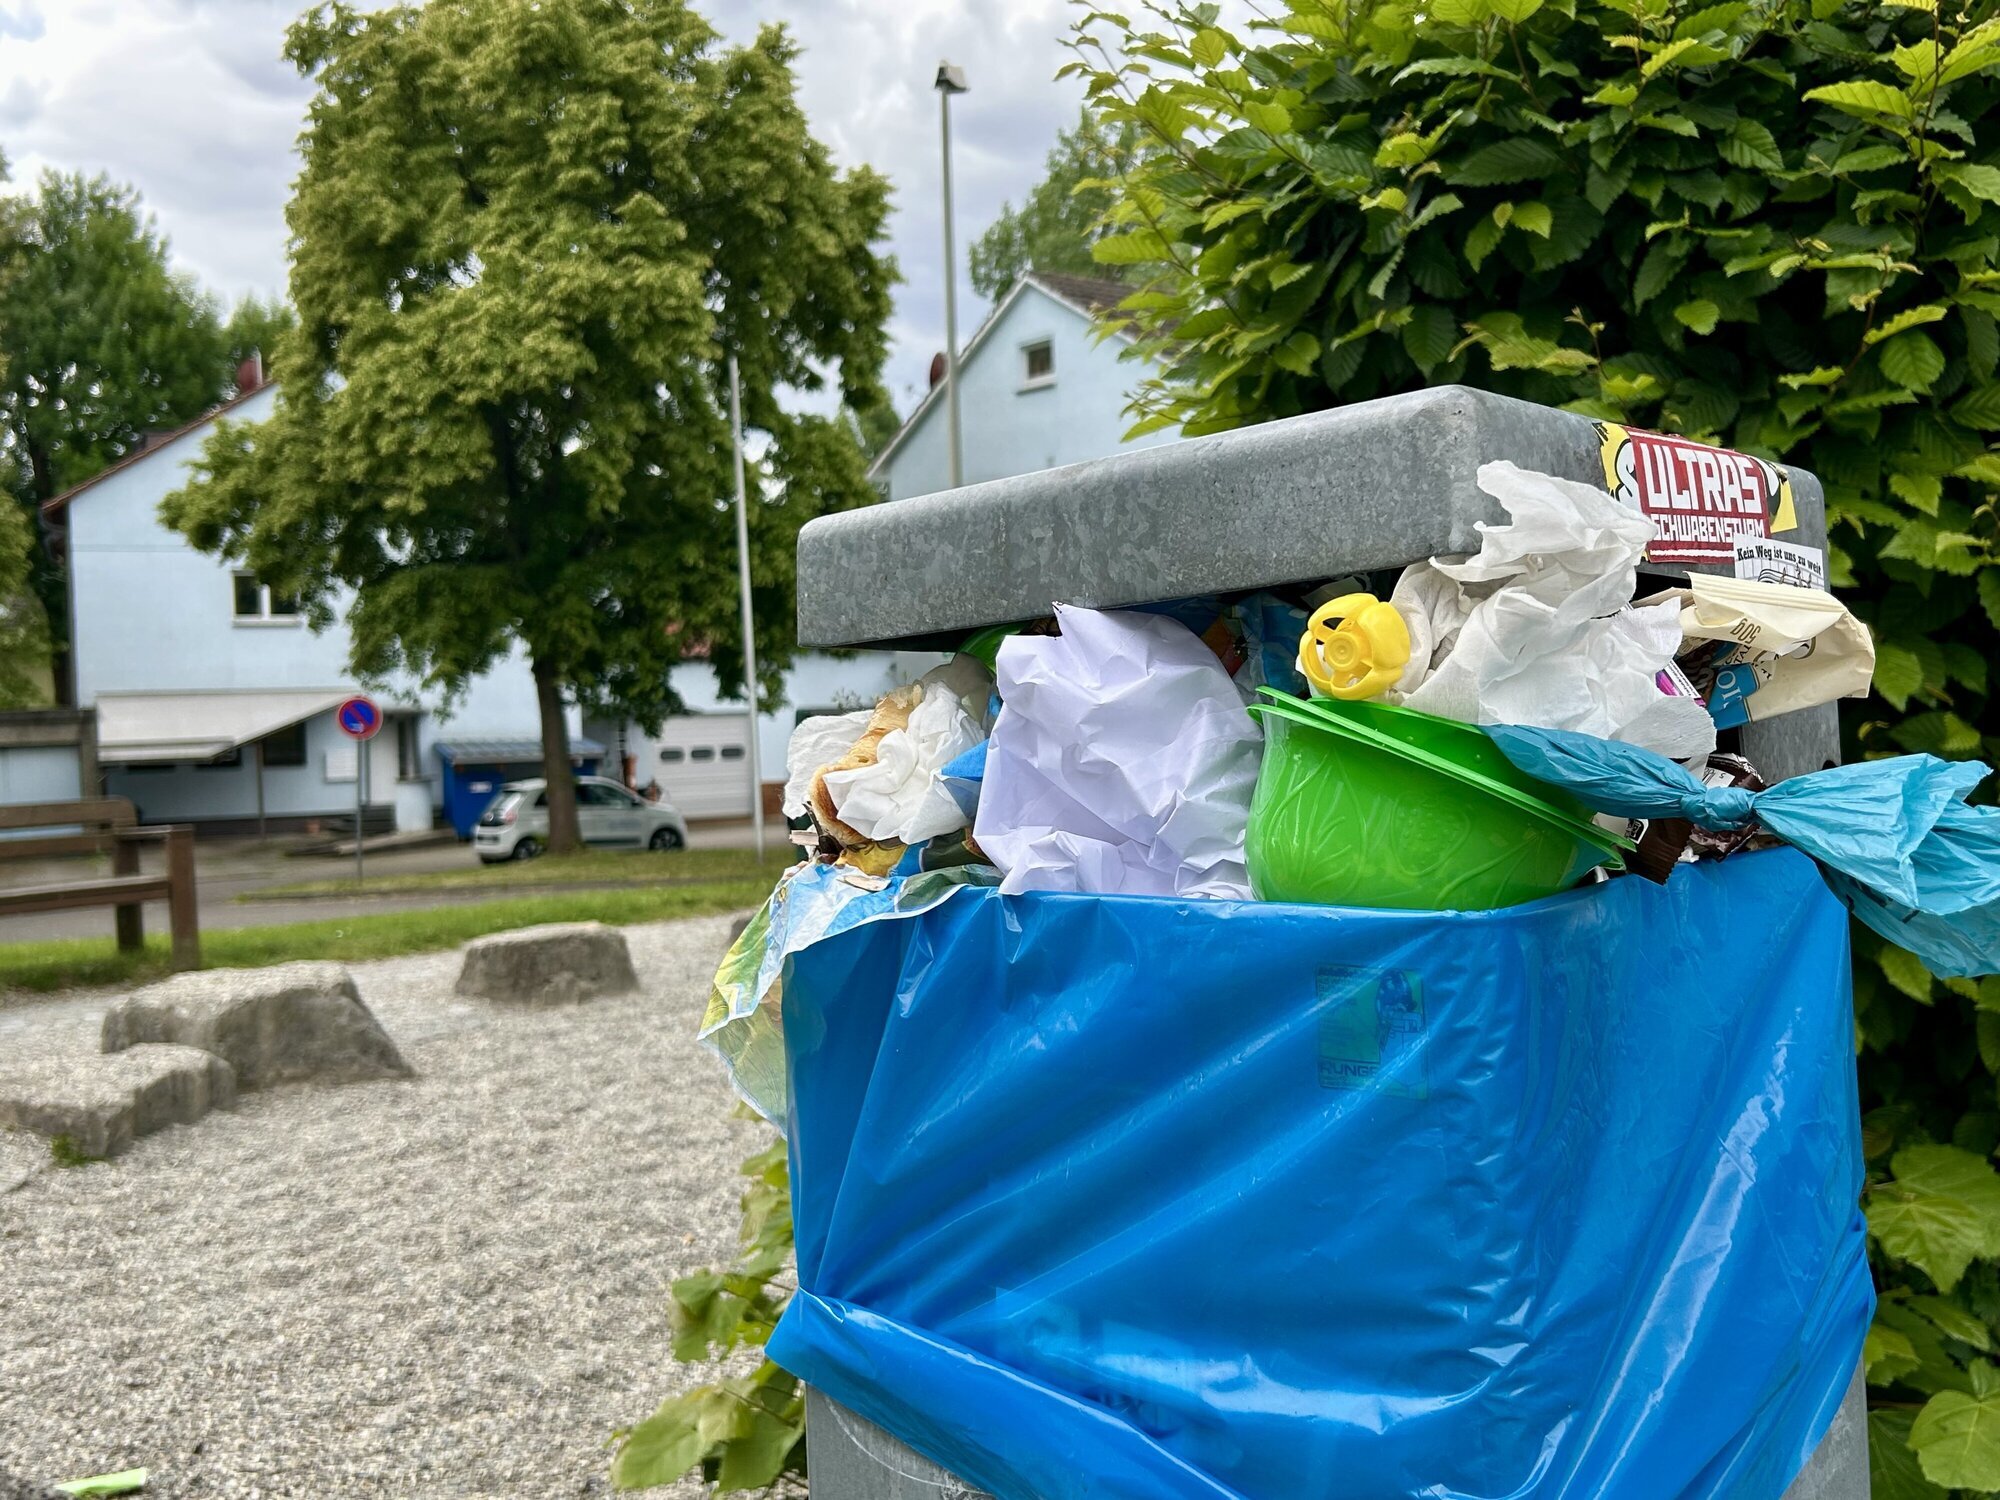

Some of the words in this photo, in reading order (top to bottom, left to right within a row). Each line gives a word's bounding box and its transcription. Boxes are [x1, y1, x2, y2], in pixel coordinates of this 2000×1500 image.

[1639, 442, 1762, 514] ULTRAS
[1737, 546, 1755, 561] Kein
[1755, 545, 1773, 561] Weg
[1774, 546, 1783, 559] ist
[1784, 550, 1797, 563] uns
[1797, 555, 1806, 566] zu
[1807, 560, 1821, 575] weit
